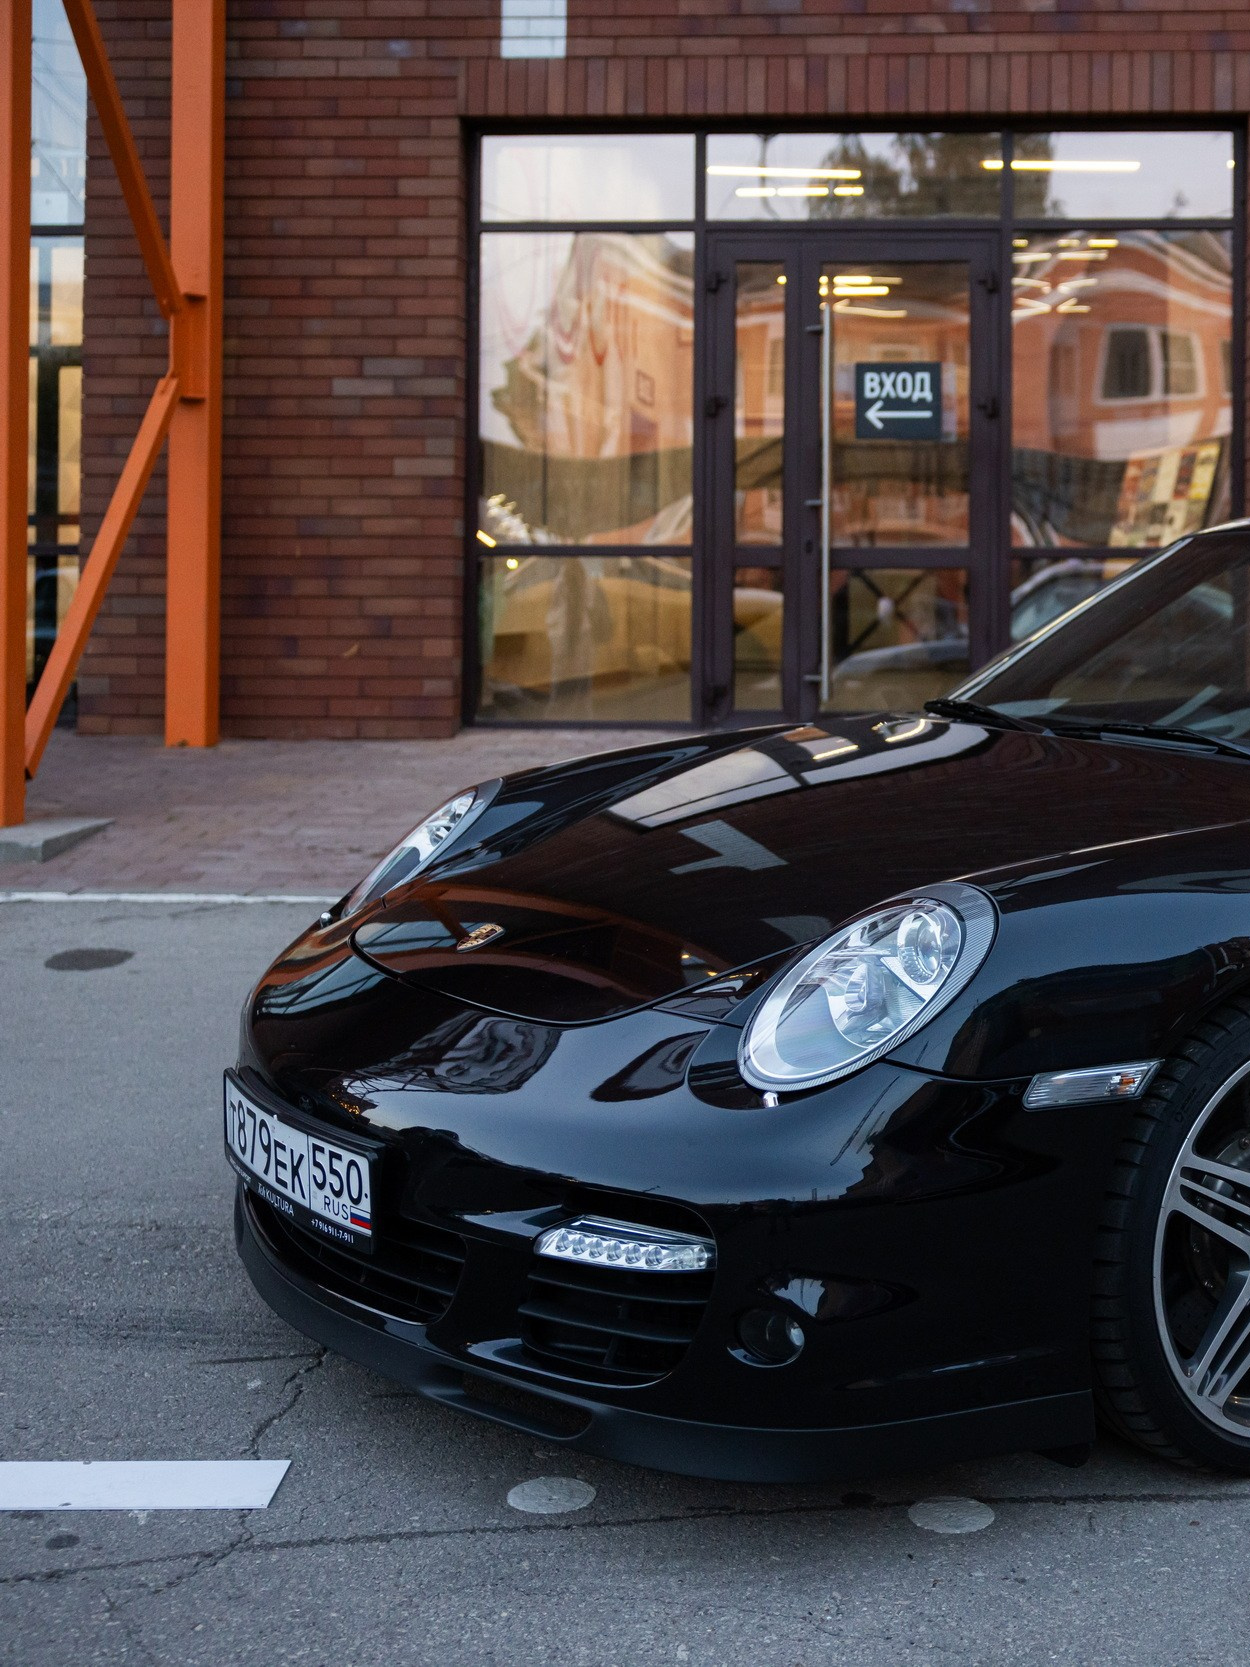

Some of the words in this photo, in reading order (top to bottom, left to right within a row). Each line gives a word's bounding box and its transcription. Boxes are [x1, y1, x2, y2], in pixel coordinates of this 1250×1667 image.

[864, 371, 933, 402] ВХОД
[311, 1142, 363, 1206] 550
[323, 1194, 349, 1221] RUS
